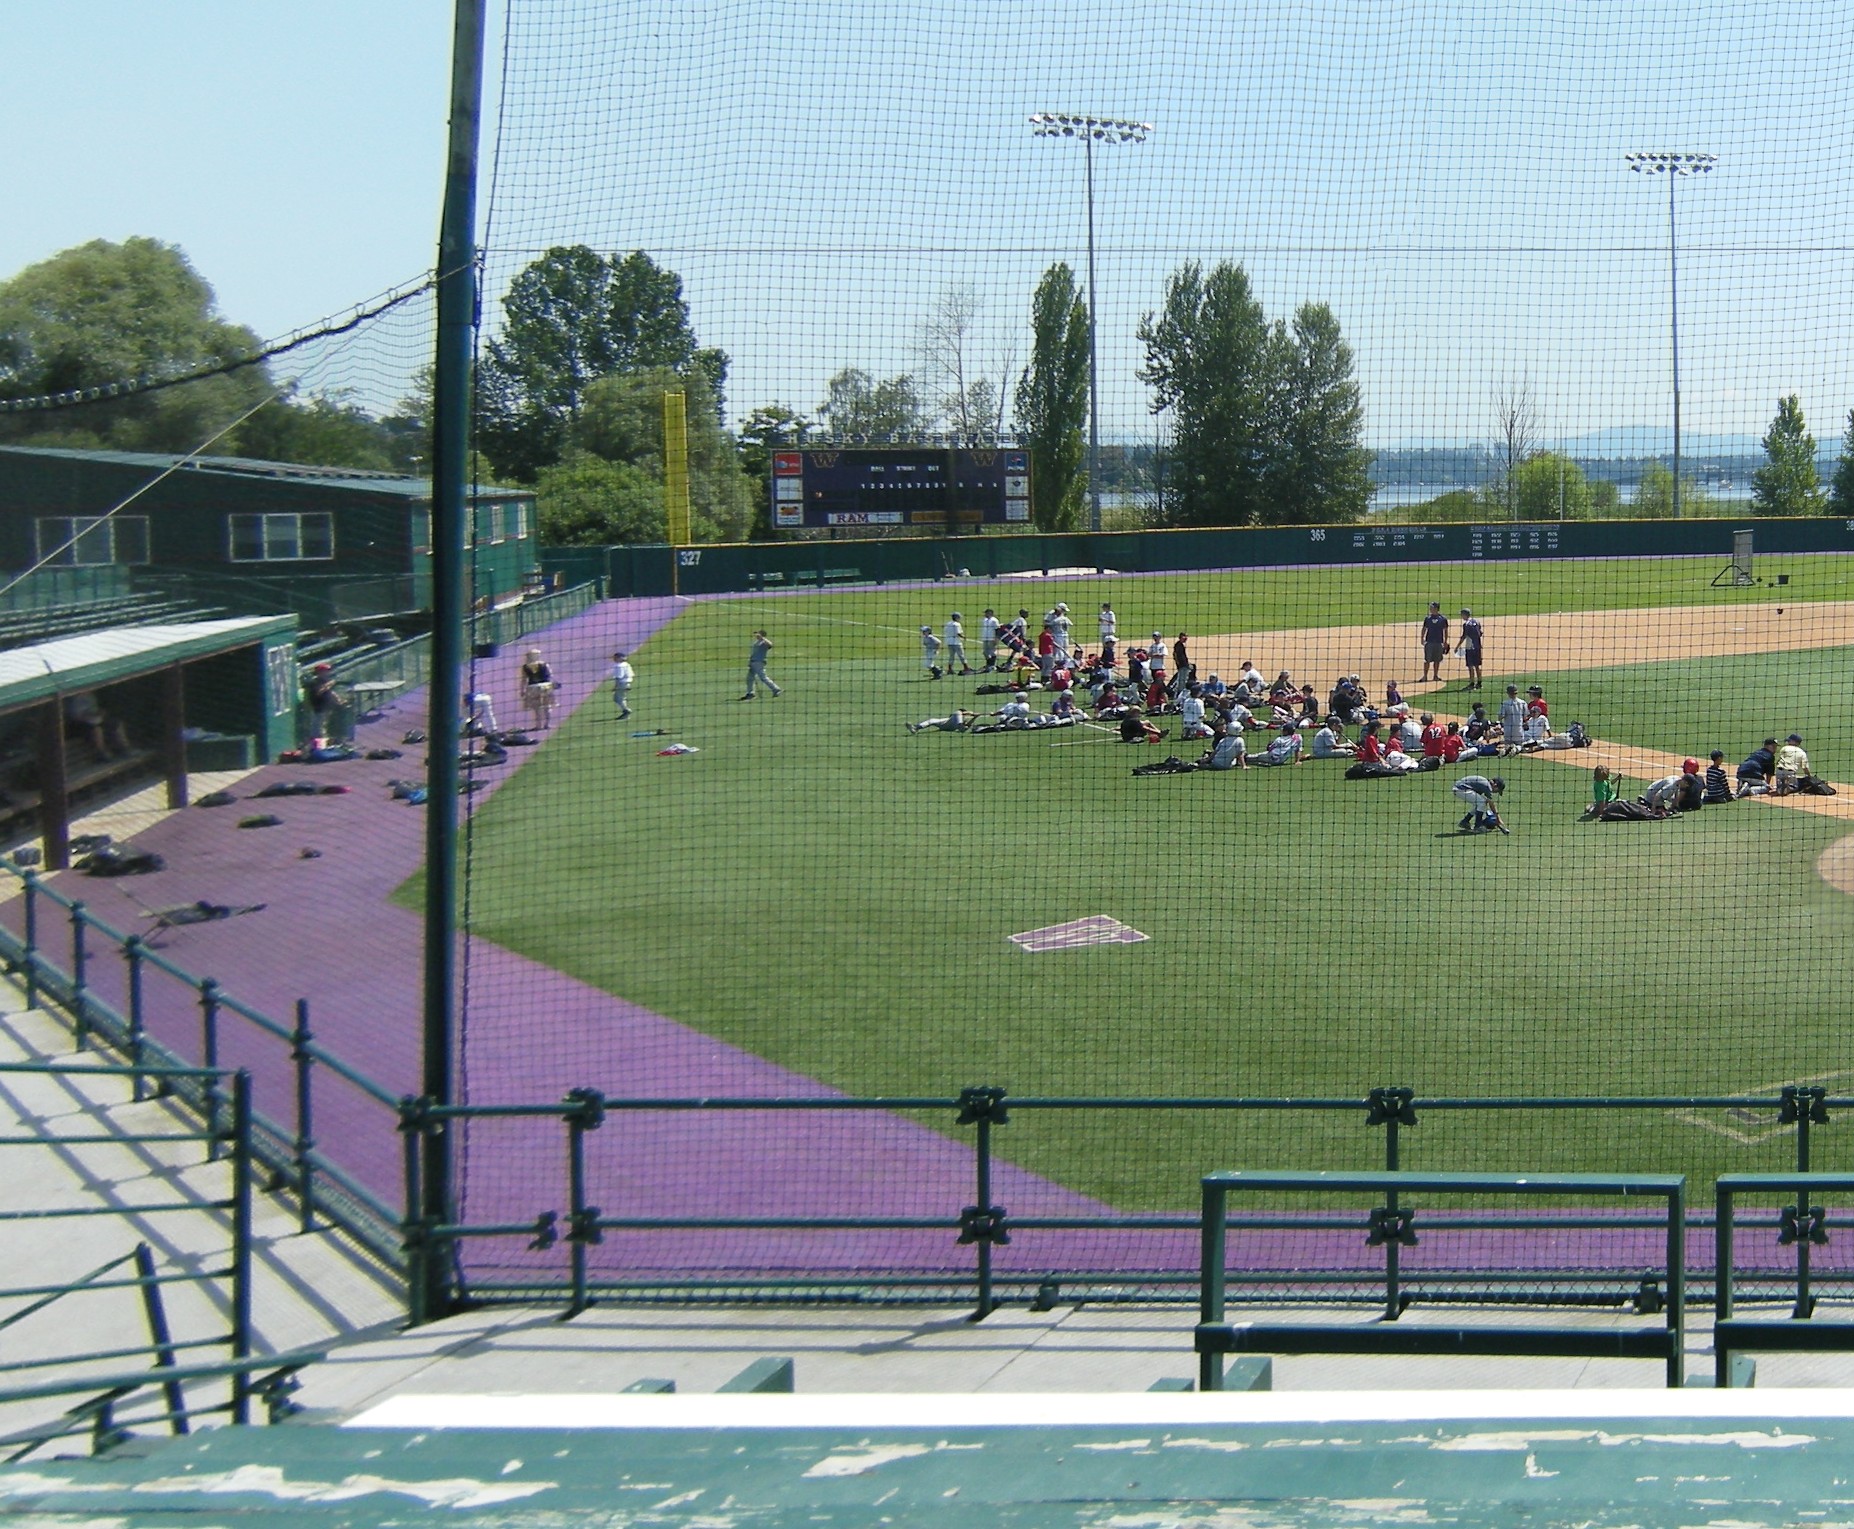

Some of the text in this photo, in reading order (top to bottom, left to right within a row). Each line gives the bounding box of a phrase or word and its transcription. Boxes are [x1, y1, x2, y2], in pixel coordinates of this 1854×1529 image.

[787, 433, 1019, 444] HUSKY BASEBALL
[836, 513, 869, 524] RAM
[1310, 528, 1326, 541] 365
[680, 550, 702, 566] 327
[1428, 726, 1442, 740] 12
